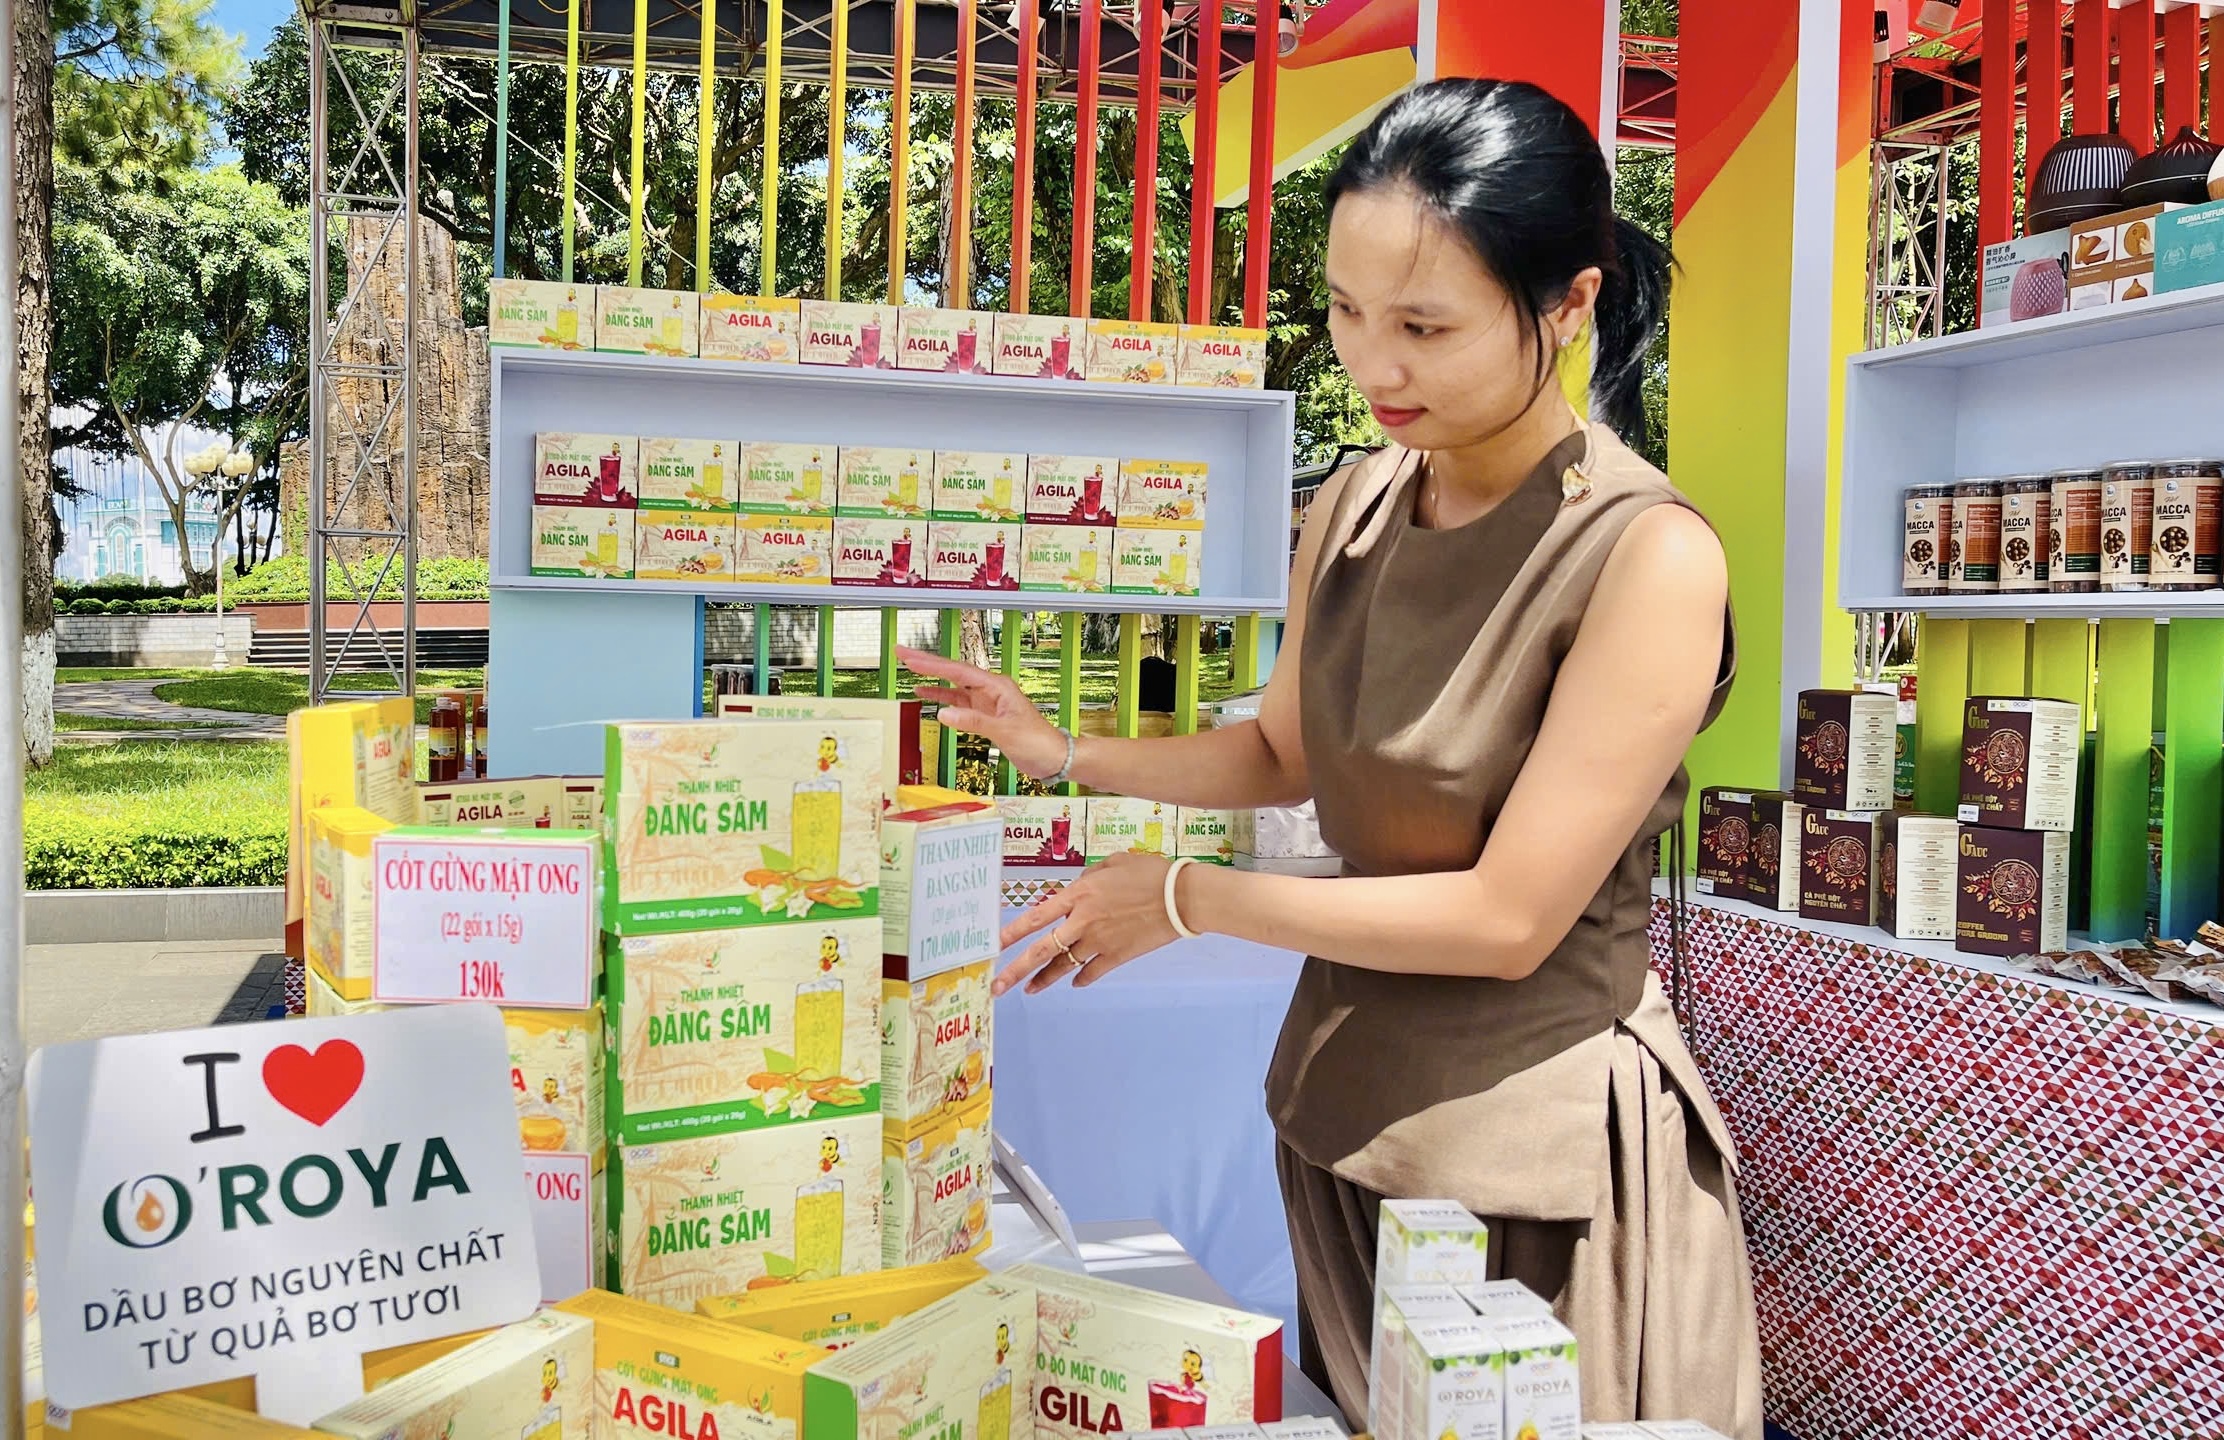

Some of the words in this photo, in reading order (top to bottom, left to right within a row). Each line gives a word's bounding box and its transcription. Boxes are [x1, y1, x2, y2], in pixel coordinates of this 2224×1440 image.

[728, 313, 772, 328] AGILA
[810, 332, 852, 347] AGILA
[907, 338, 949, 353] AGILA
[1112, 337, 1151, 351] AGILA
[1003, 344, 1043, 359] AGILA
[1202, 343, 1241, 357] AGILA
[545, 463, 591, 478] AGILA
[1035, 484, 1076, 498] AGILA
[1144, 476, 1182, 490] AGILA
[2156, 504, 2190, 515] MACCA
[1907, 520, 1934, 531] MACCA
[2003, 517, 2030, 528] MACCA
[663, 528, 707, 542] AGILA
[763, 532, 805, 546] AGILA
[842, 548, 884, 562] AGILA
[937, 551, 977, 565] AGILA
[457, 804, 503, 823] AGILA
[717, 795, 768, 833] SÂM
[1004, 826, 1044, 840] AGILA
[921, 838, 960, 866] THANH
[963, 831, 999, 858] NHIỆT
[385, 850, 425, 890] CỐT
[429, 852, 485, 893] GỪNG
[490, 857, 532, 901] MẬT
[538, 863, 579, 894] ONG
[440, 913, 462, 944] (22
[464, 914, 483, 944] gói
[485, 922, 494, 938] x
[496, 914, 524, 945] 15g)
[920, 929, 960, 962] 170.000
[460, 960, 505, 999] 130k
[681, 988, 713, 1004] THANH
[649, 998, 711, 1047] ĐẲNG
[721, 999, 771, 1038] SÂM
[934, 1013, 970, 1048] AGILA
[183, 1051, 246, 1144] I
[102, 1135, 472, 1249] O'ROYA
[537, 1172, 581, 1201] ONG
[933, 1164, 971, 1203] AGILA
[680, 1197, 713, 1213] THANH
[716, 1190, 744, 1210] NHIỆT
[648, 1207, 711, 1257] ĐẲNG
[720, 1205, 771, 1246] SÂM
[84, 1286, 168, 1332] DẦU
[184, 1277, 241, 1313] BƠ
[251, 1249, 404, 1303] NGUYÊN
[416, 1226, 507, 1272] CHẤT
[139, 1329, 200, 1371] TỪ
[211, 1307, 295, 1362] QUẢ
[307, 1301, 360, 1339] BƠ
[368, 1284, 461, 1328] TƯƠI
[863, 1320, 881, 1334] ONG
[1100, 1370, 1127, 1393] ONG
[696, 1383, 719, 1404] ONG
[613, 1386, 721, 1440] AGILA
[1036, 1385, 1124, 1435] GILA
